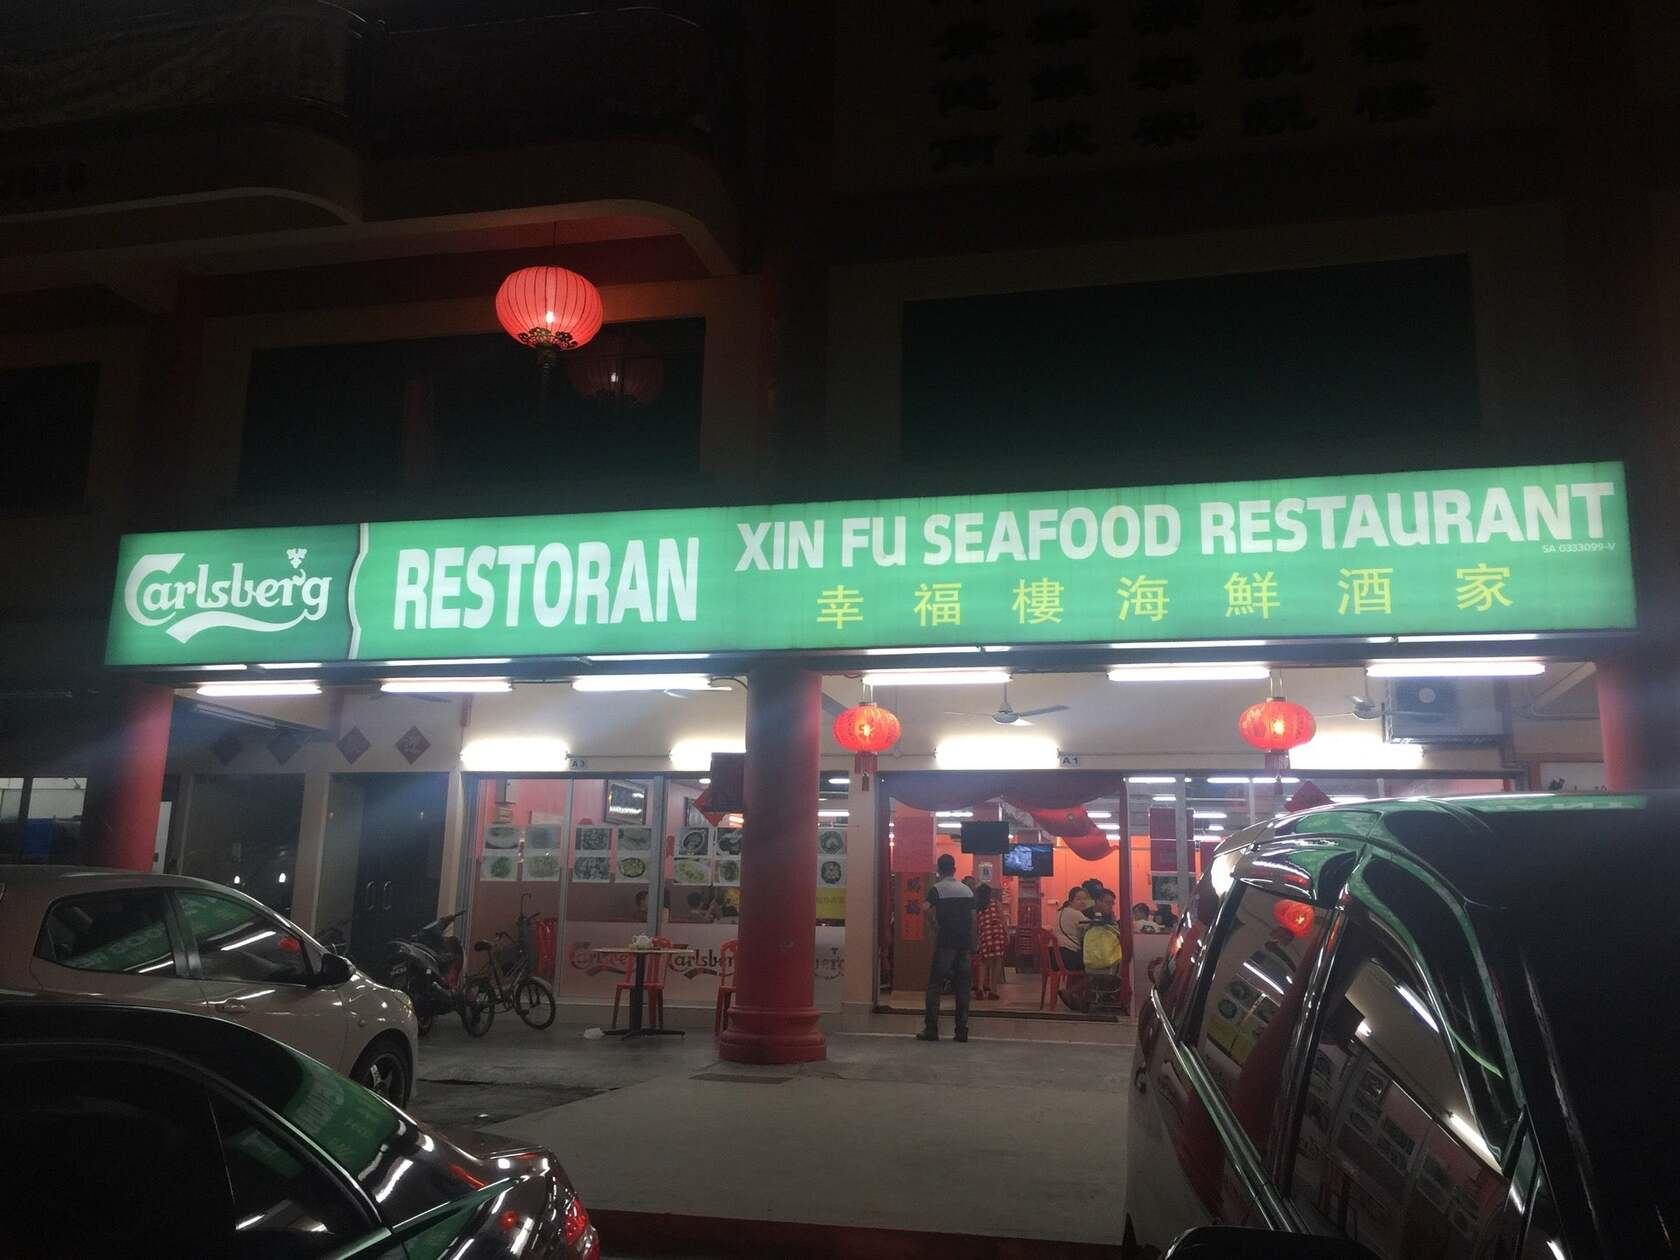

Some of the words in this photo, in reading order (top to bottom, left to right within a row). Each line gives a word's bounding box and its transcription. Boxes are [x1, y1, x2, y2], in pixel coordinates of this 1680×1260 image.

[735, 520, 824, 572] XIN
[841, 516, 906, 568] FU
[923, 504, 1182, 565] SEAFOOD
[1200, 482, 1615, 555] RESTAURANT
[124, 553, 333, 628] Carlsberg
[394, 537, 699, 629] RESTORAN
[816, 564, 1514, 630] 幸福樓海鮮酒家
